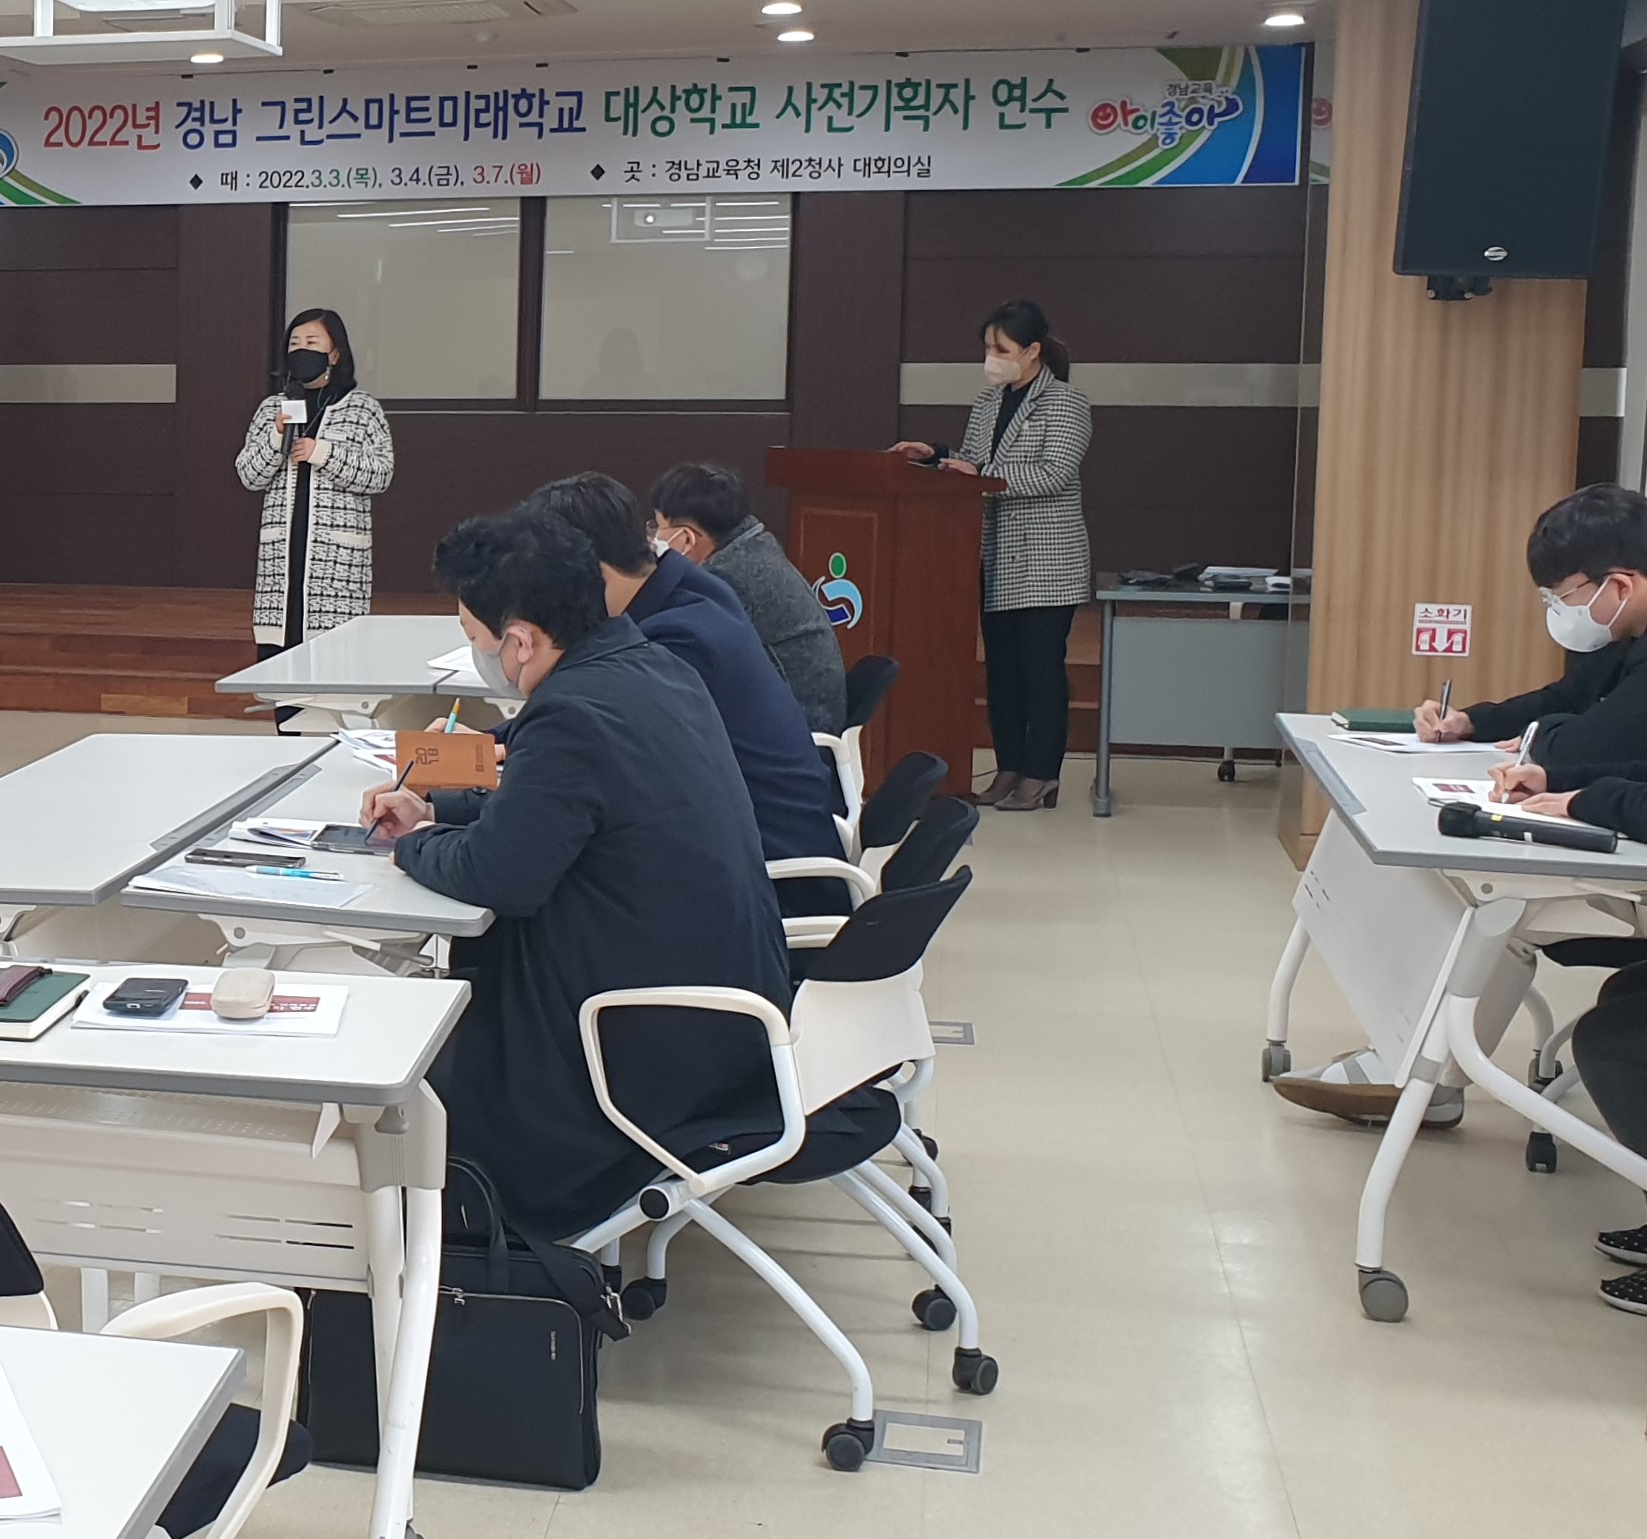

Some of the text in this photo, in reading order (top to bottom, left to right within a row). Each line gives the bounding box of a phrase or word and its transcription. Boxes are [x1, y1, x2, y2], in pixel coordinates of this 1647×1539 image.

[1167, 82, 1214, 97] 경남교육
[43, 76, 1070, 150] 2022년 경남 그린스마트미래학교 대상학교 사전기획자 연수
[1089, 97, 1241, 146] 아이좋아
[220, 170, 238, 191] 때
[258, 167, 383, 190] 2022.3.3.(목),
[390, 165, 465, 188] 3.4.(금),
[472, 162, 542, 185] 3.7.(월)
[623, 161, 643, 183] 곳
[664, 157, 761, 182] 경남교육청
[769, 156, 844, 180] 제2청사
[852, 155, 933, 178] 대회의실
[1418, 607, 1468, 620] 소화기
